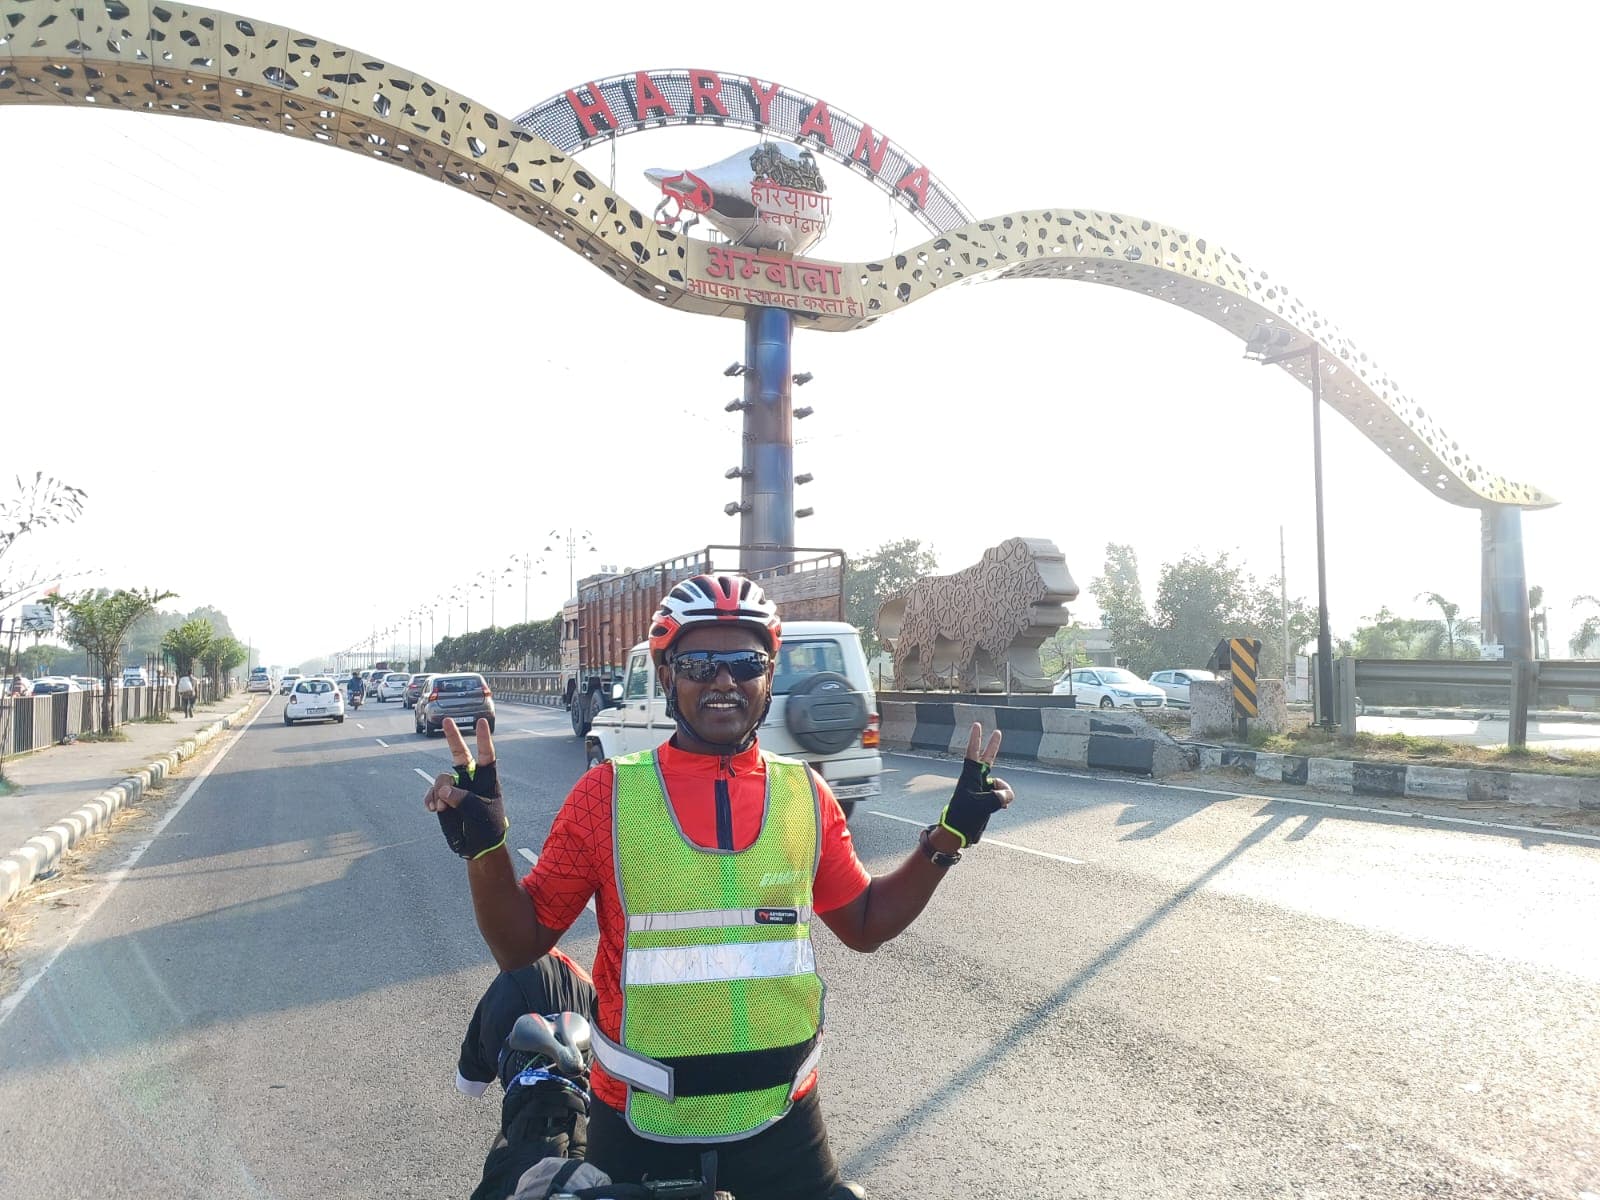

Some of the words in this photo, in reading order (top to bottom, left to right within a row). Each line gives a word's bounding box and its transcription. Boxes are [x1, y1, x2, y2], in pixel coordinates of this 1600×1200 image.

[565, 69, 931, 208] HARYANA
[750, 177, 832, 216] हरियाणा
[706, 246, 842, 296] अम्बाला
[687, 278, 741, 300] आपका
[801, 296, 845, 314] करता
